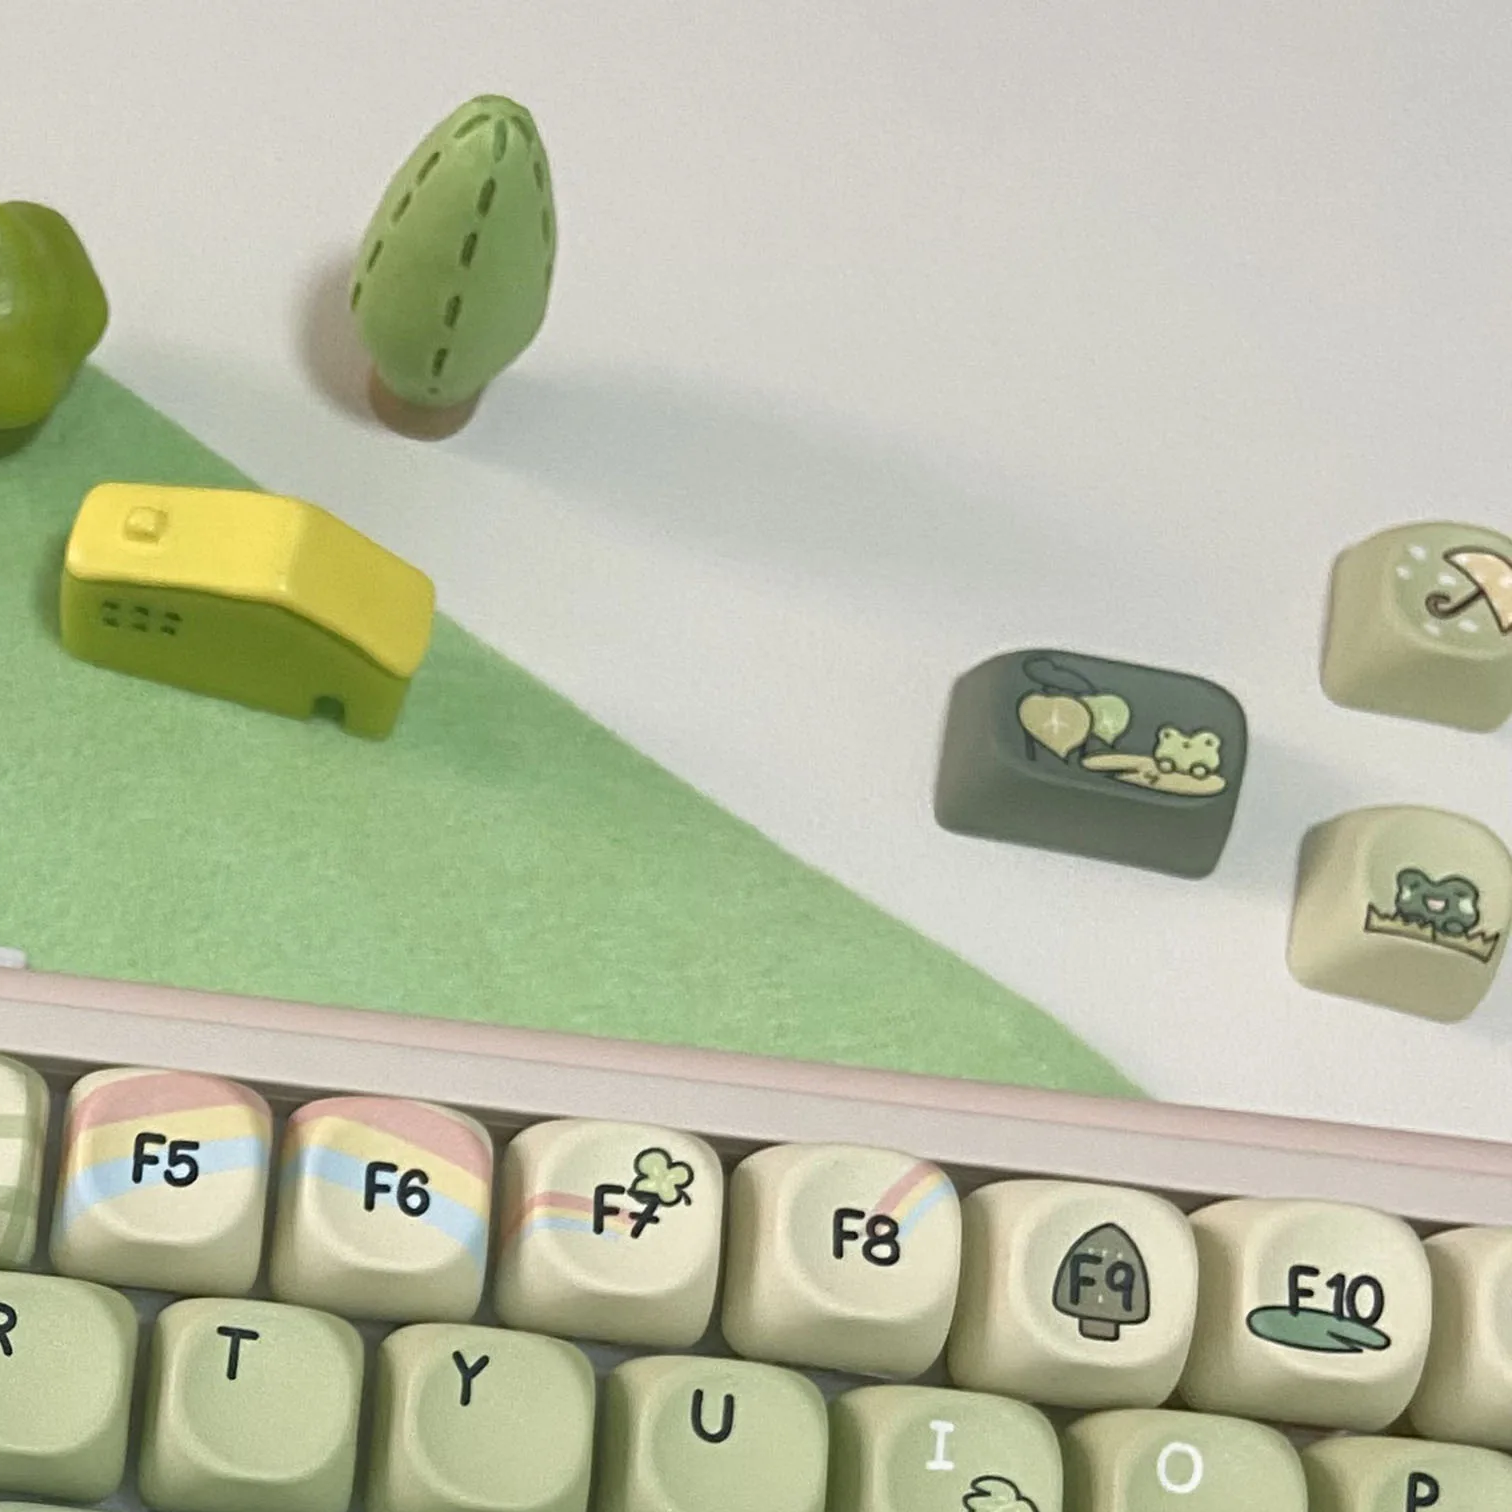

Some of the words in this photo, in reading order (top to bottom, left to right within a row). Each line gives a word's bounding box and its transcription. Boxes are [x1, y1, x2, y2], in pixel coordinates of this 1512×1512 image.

[131, 1132, 200, 1188] F5
[363, 1160, 430, 1217] F6
[592, 1184, 660, 1239] F7
[832, 1208, 901, 1266] F8
[1068, 1254, 1134, 1311] F9
[1288, 1265, 1385, 1327] F10
[217, 1326, 259, 1380] T
[452, 1350, 489, 1406] Y
[691, 1388, 735, 1443] U
[925, 1420, 954, 1472] I
[1156, 1442, 1204, 1495] O
